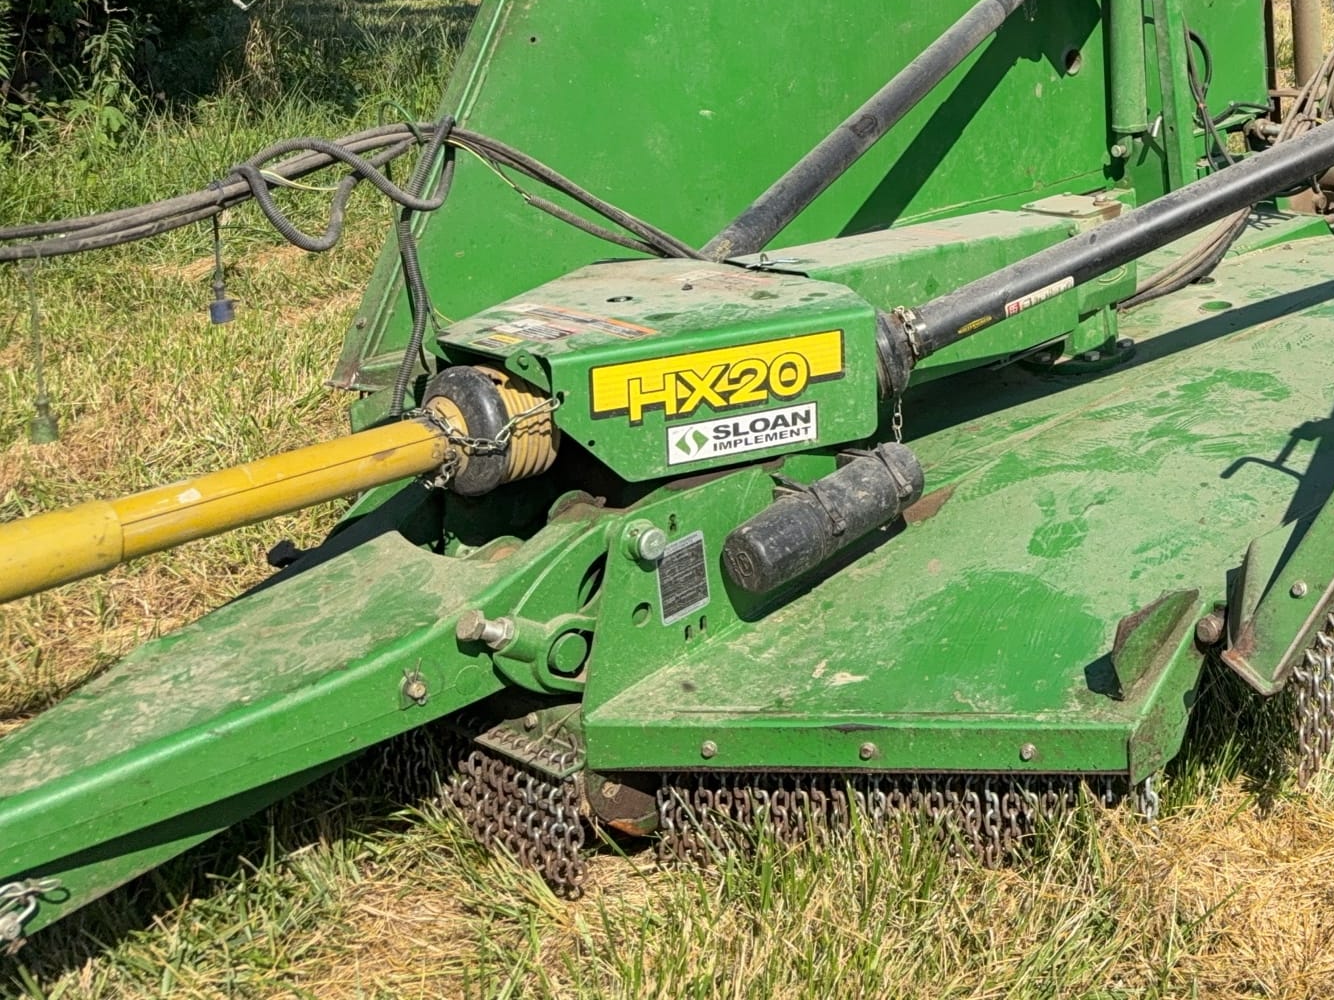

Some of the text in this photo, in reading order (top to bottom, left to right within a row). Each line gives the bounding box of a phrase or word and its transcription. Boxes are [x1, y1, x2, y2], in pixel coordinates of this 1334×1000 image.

[628, 353, 809, 425] HX20
[713, 410, 811, 440] SLOAN
[713, 427, 811, 452] IMPLEMENT
